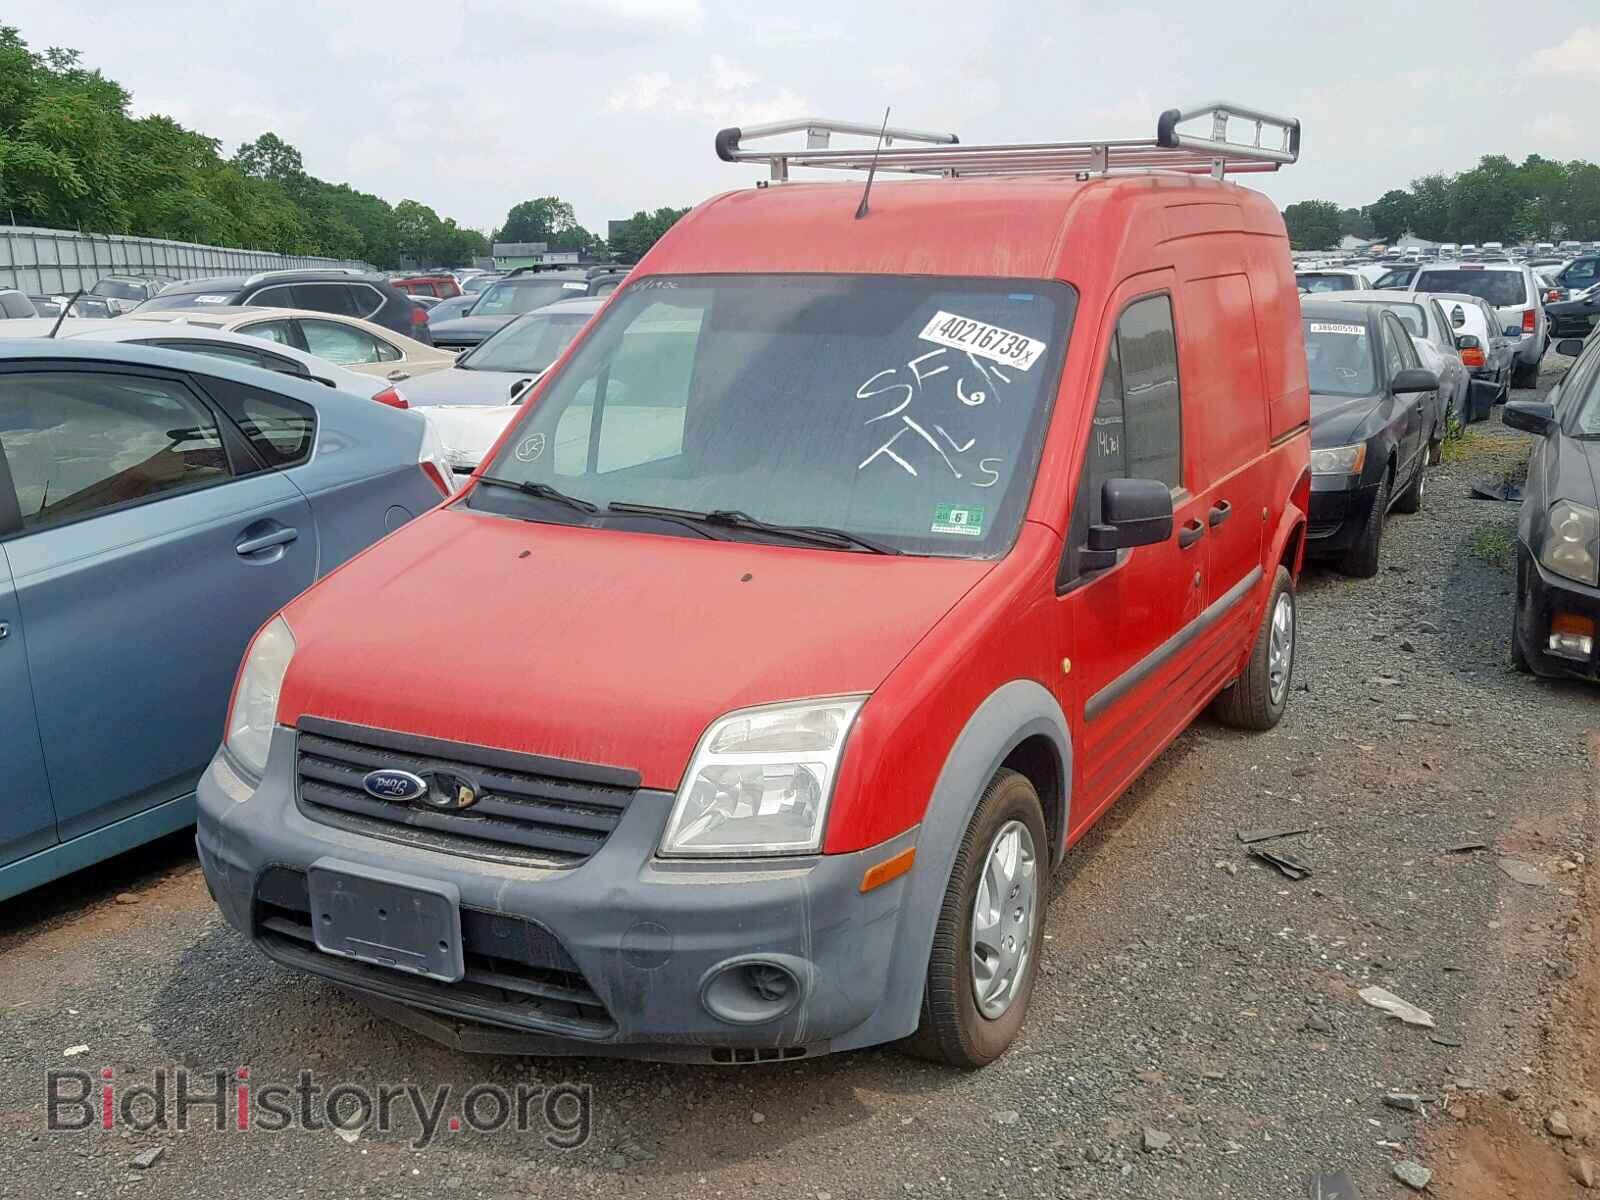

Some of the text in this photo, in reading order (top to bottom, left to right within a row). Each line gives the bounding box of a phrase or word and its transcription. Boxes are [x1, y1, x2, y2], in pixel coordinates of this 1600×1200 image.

[939, 316, 1030, 359] 40216739
[954, 513, 962, 523] 6
[376, 777, 408, 796] Ford
